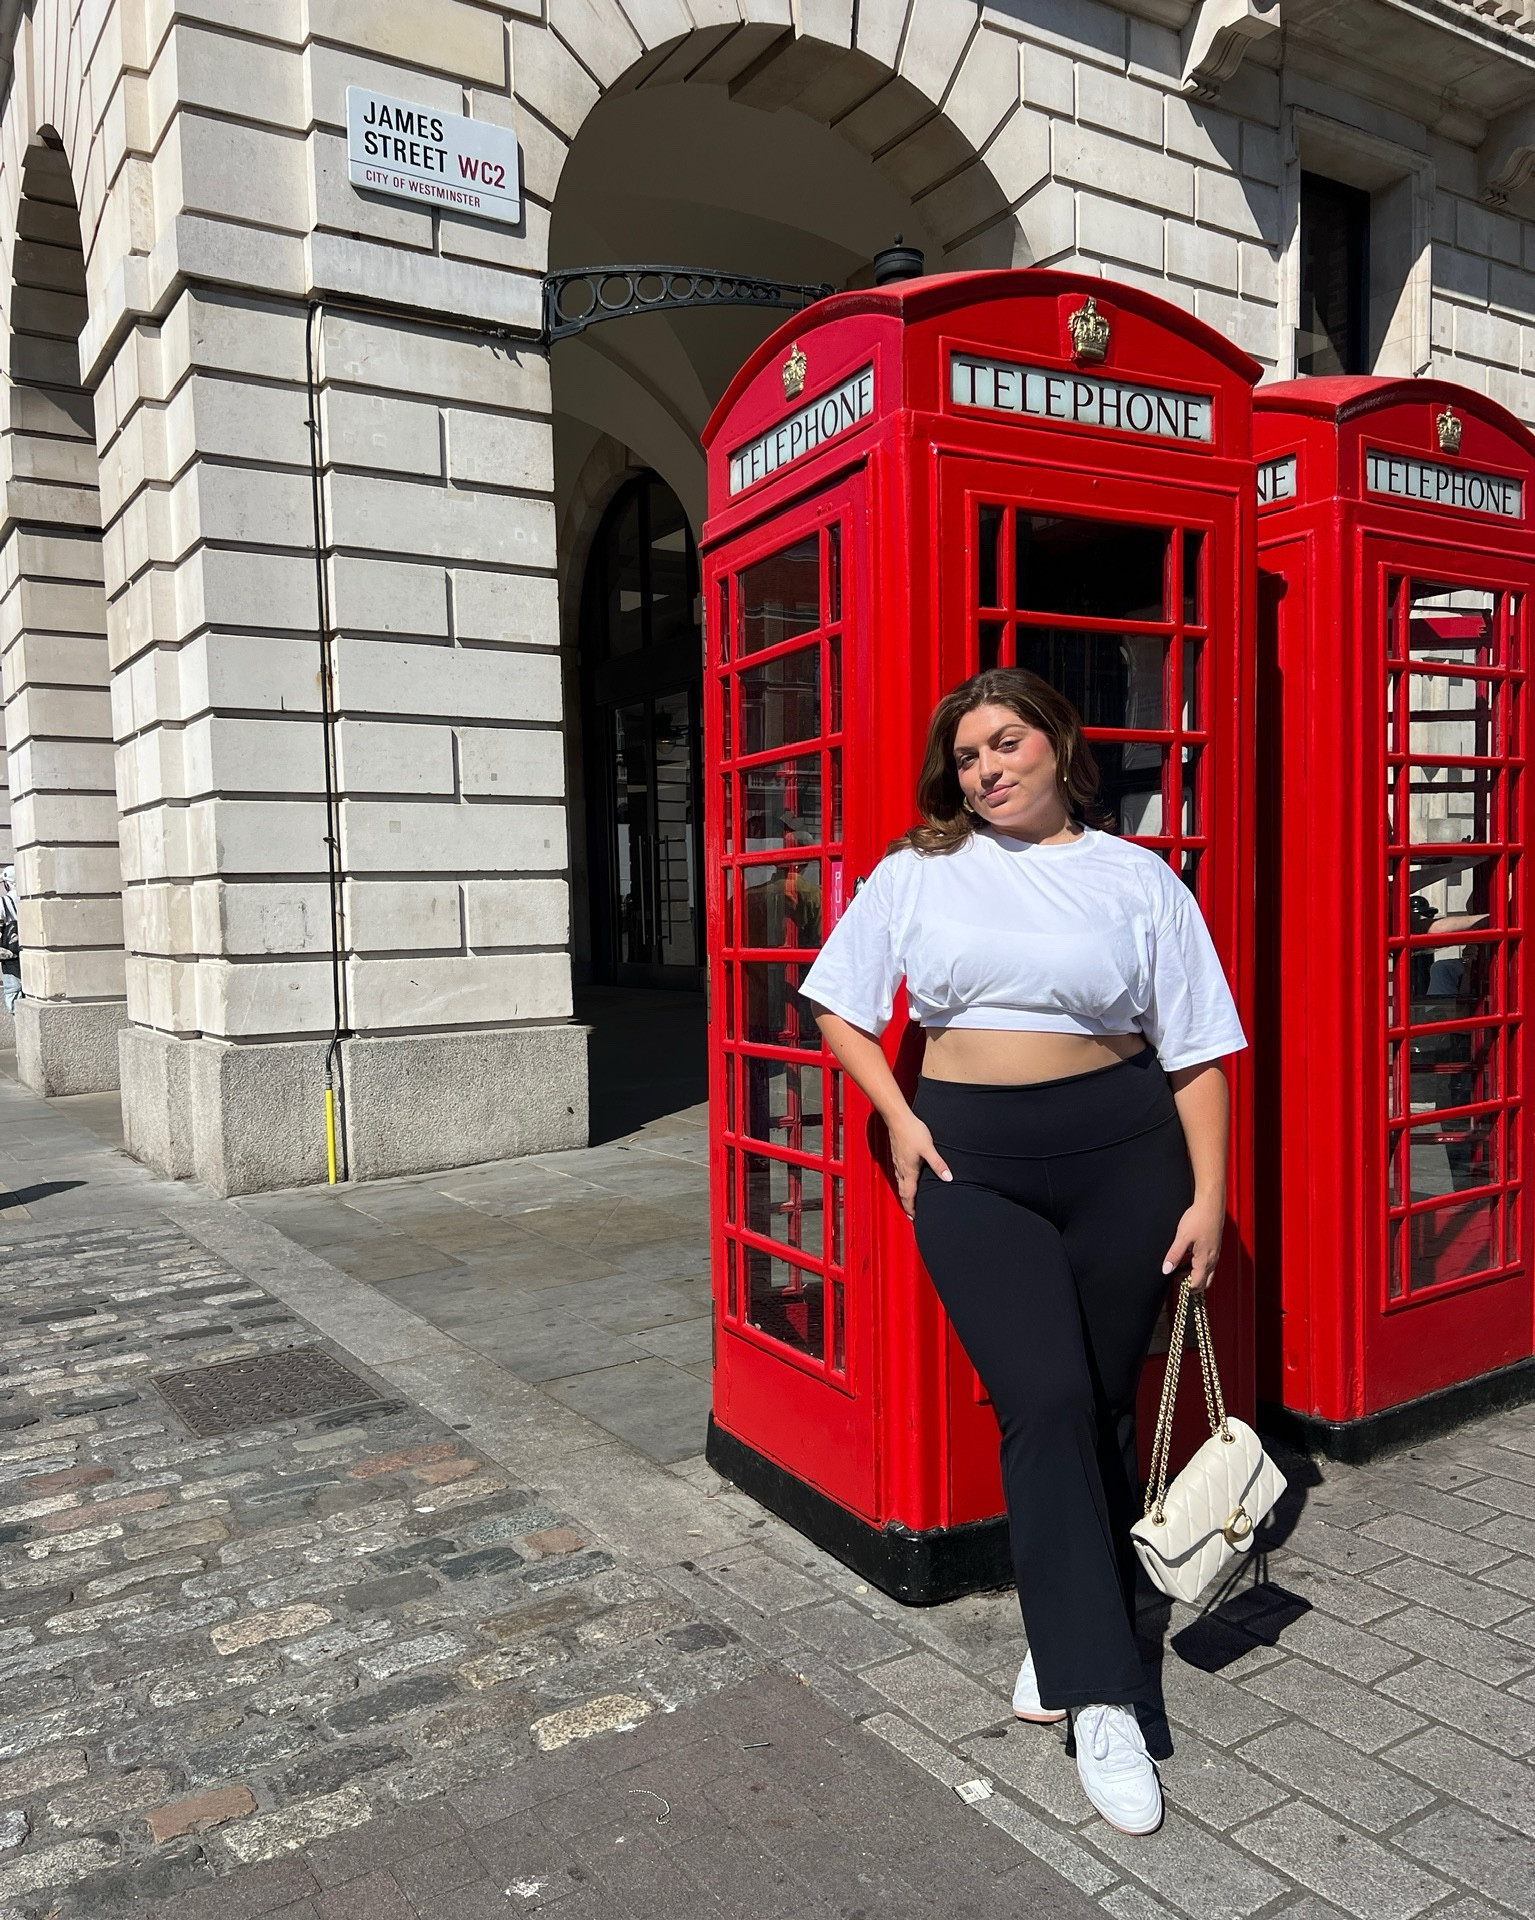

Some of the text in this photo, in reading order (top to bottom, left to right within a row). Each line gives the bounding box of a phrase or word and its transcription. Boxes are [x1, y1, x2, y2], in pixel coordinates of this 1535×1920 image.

[363, 101, 444, 142] JAMES
[364, 131, 506, 189] STREET WC2
[366, 169, 481, 208] CITY OF WESTMINSTER
[958, 362, 1202, 439] TELEPHONE
[736, 374, 871, 489] TELEPHONE
[1368, 455, 1514, 515] TELEPHONE
